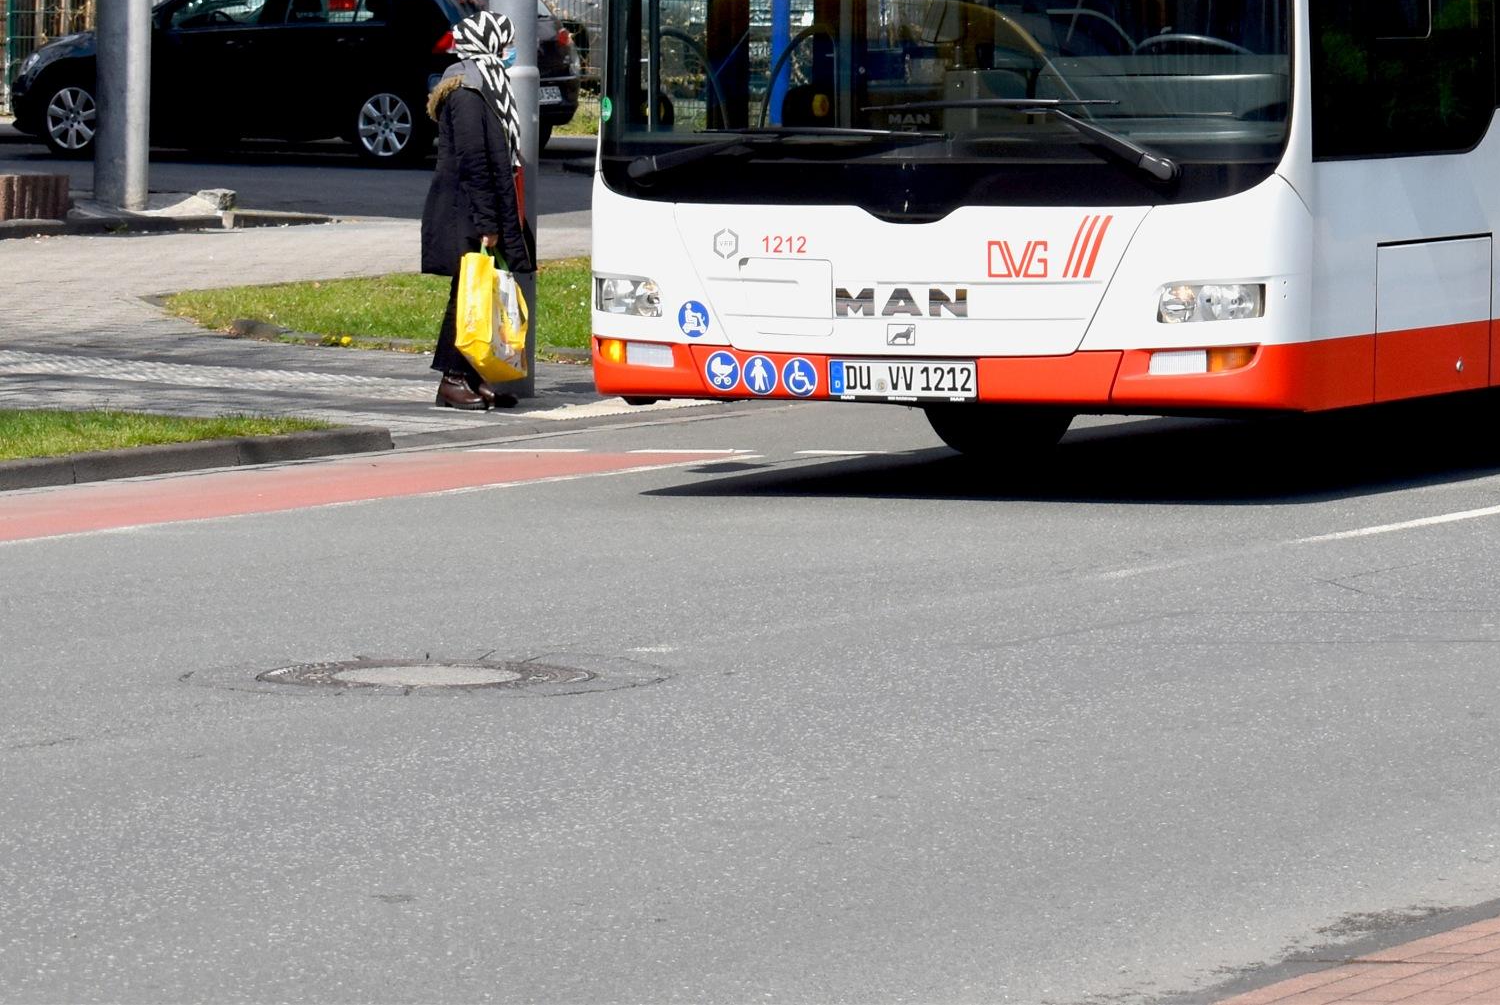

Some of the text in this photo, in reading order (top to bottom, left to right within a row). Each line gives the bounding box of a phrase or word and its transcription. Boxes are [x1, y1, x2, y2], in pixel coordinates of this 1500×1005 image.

[762, 235, 807, 253] 1212
[987, 241, 1048, 277] DVG
[835, 288, 968, 317] MAN
[845, 365, 872, 390] DU
[888, 366, 914, 391] VV
[920, 366, 972, 392] 1212
